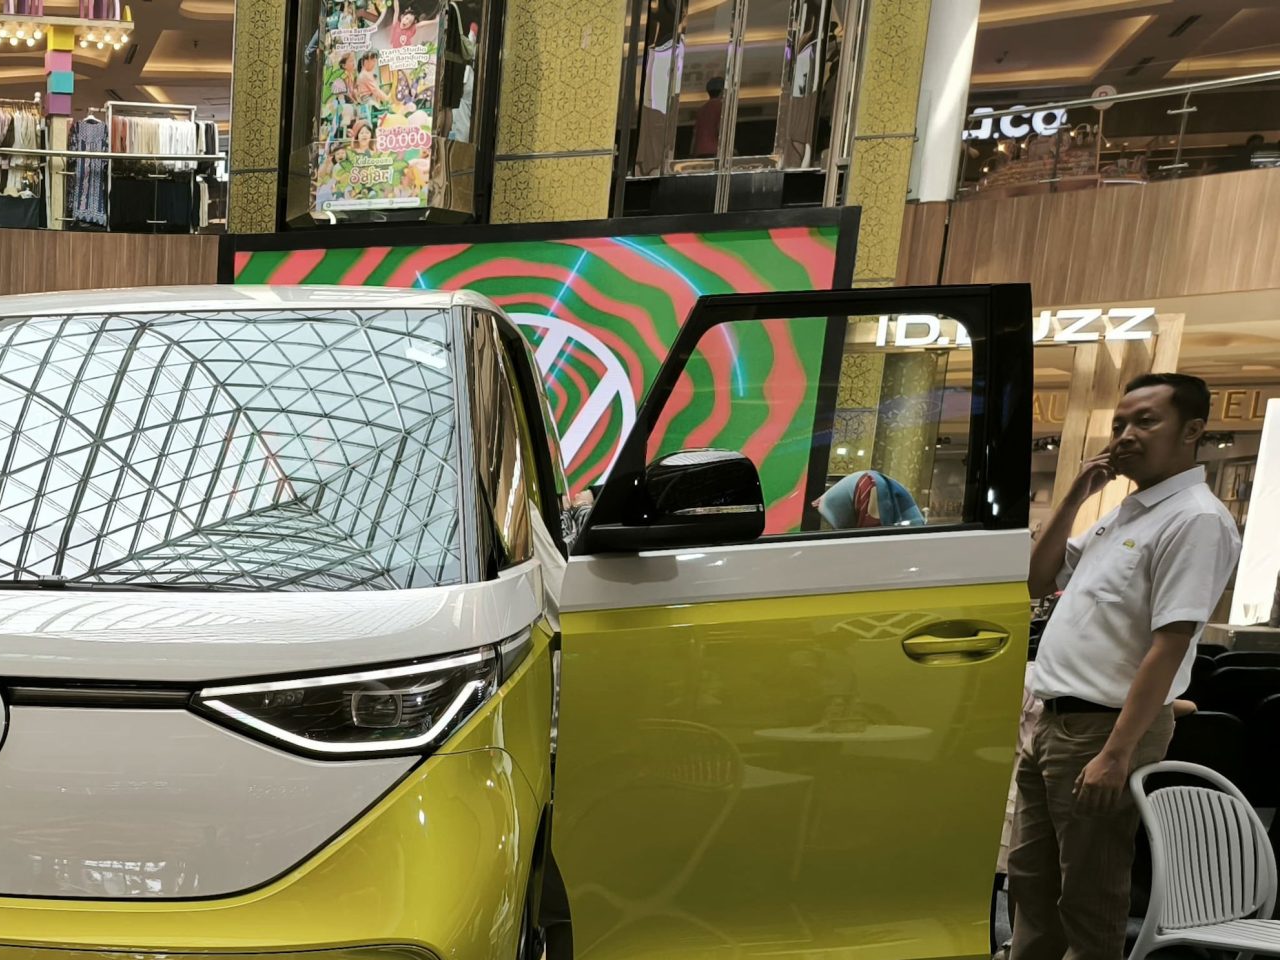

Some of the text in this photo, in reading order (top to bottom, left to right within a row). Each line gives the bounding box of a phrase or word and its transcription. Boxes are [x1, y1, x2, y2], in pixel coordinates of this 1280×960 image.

[381, 48, 400, 56] Trans
[395, 54, 428, 62] Bandung
[378, 132, 427, 148] 80.000
[350, 166, 394, 186] Safari
